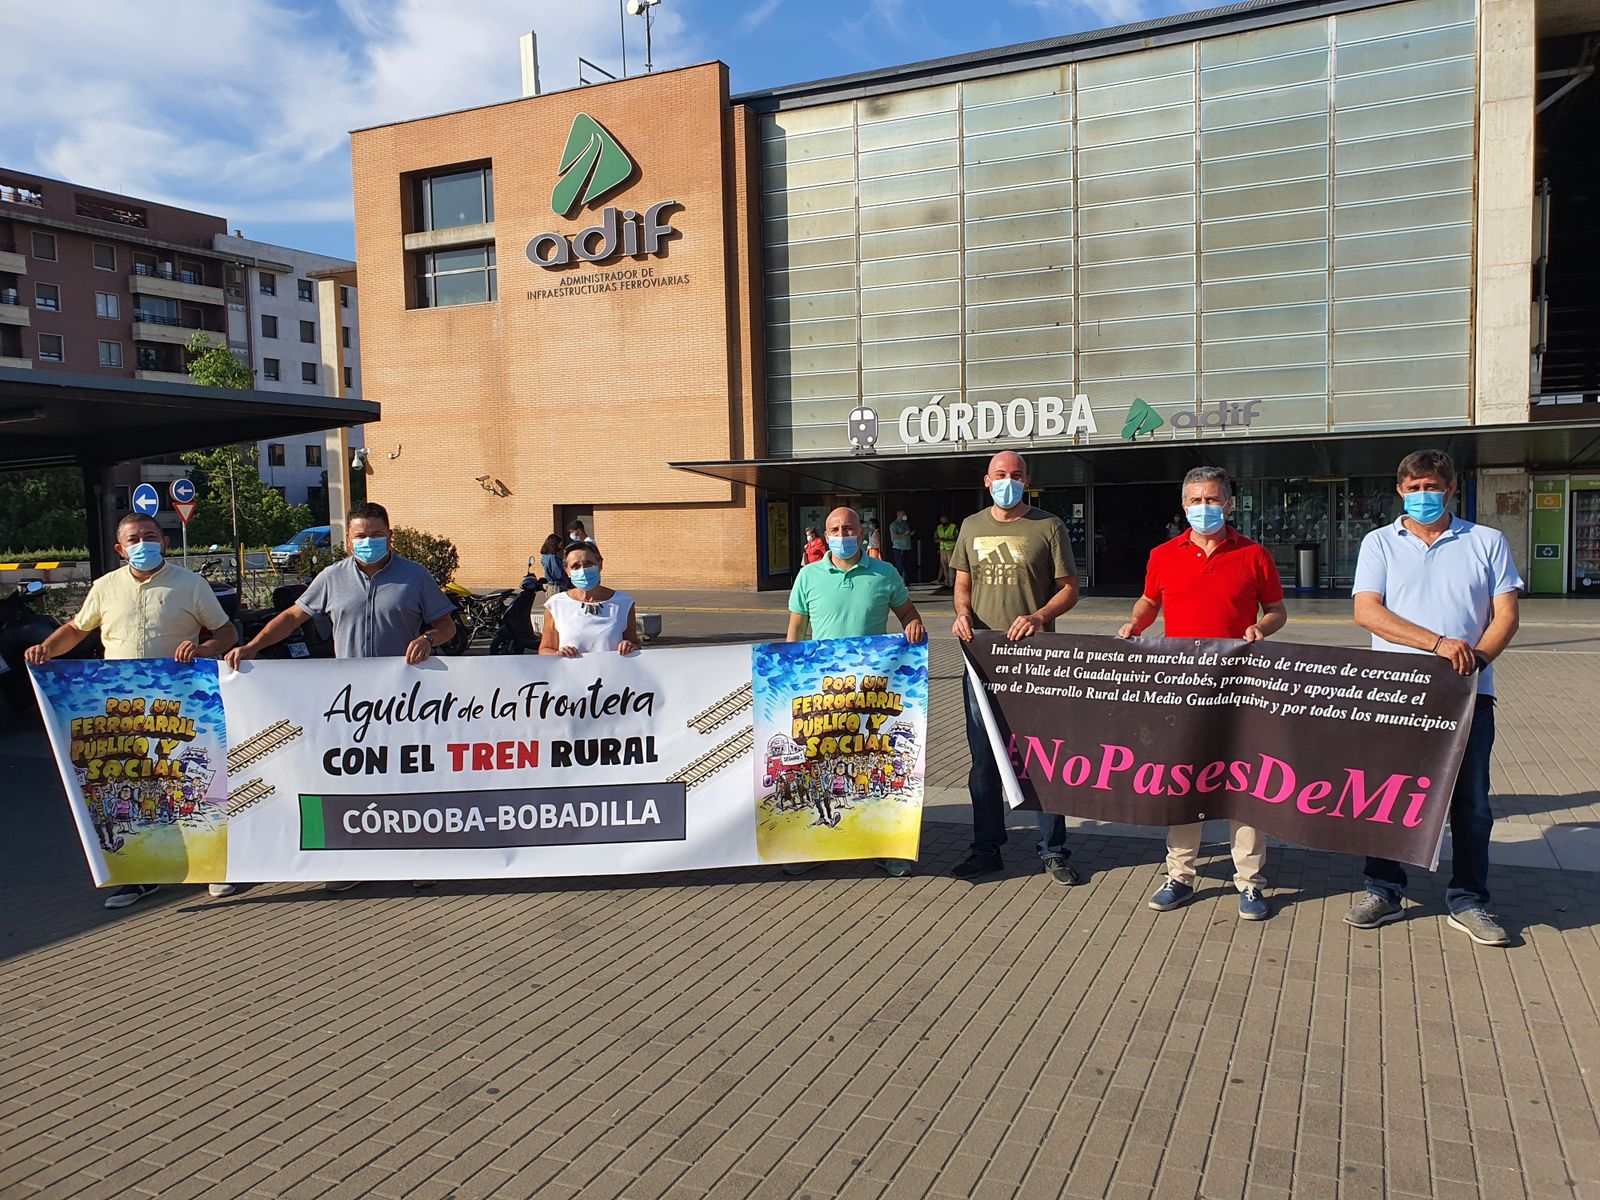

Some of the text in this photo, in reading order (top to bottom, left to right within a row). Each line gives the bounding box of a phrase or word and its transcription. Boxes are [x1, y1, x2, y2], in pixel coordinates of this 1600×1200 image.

[525, 199, 676, 267] adif
[527, 275, 690, 300] INFRAESTRUCTURAS FERROVIARIAS
[559, 268, 654, 287] ADMINISTRADOR DE
[899, 394, 1098, 444] CÓRDOBA
[1169, 400, 1262, 429] adif
[991, 643, 1432, 685] Iniciativa para la puesta en marcha del servicio de trenes de cercanías
[822, 675, 889, 693] POR UN
[995, 662, 1427, 706] en el Valle del Guadalquivir Cordobés, promovida y apoyada desde el
[105, 697, 182, 716] POR UN
[323, 677, 656, 743] Aguilar de la Frontera
[792, 691, 904, 716] FERROCARRIL
[981, 679, 1458, 732] rupo de Desarrollo Rural del Medio Guadalquivir y por todos los municipios
[70, 714, 198, 740] FERROCARRIL
[792, 711, 889, 742] PÚBLICO Y
[70, 734, 181, 765] PÚBLICO Y
[322, 736, 659, 777] CON EL TREN RURAL
[805, 733, 896, 759] SOCIAL
[86, 757, 187, 782] SOCIAL
[342, 799, 662, 834] CÓRDOBA-BOBADILLA
